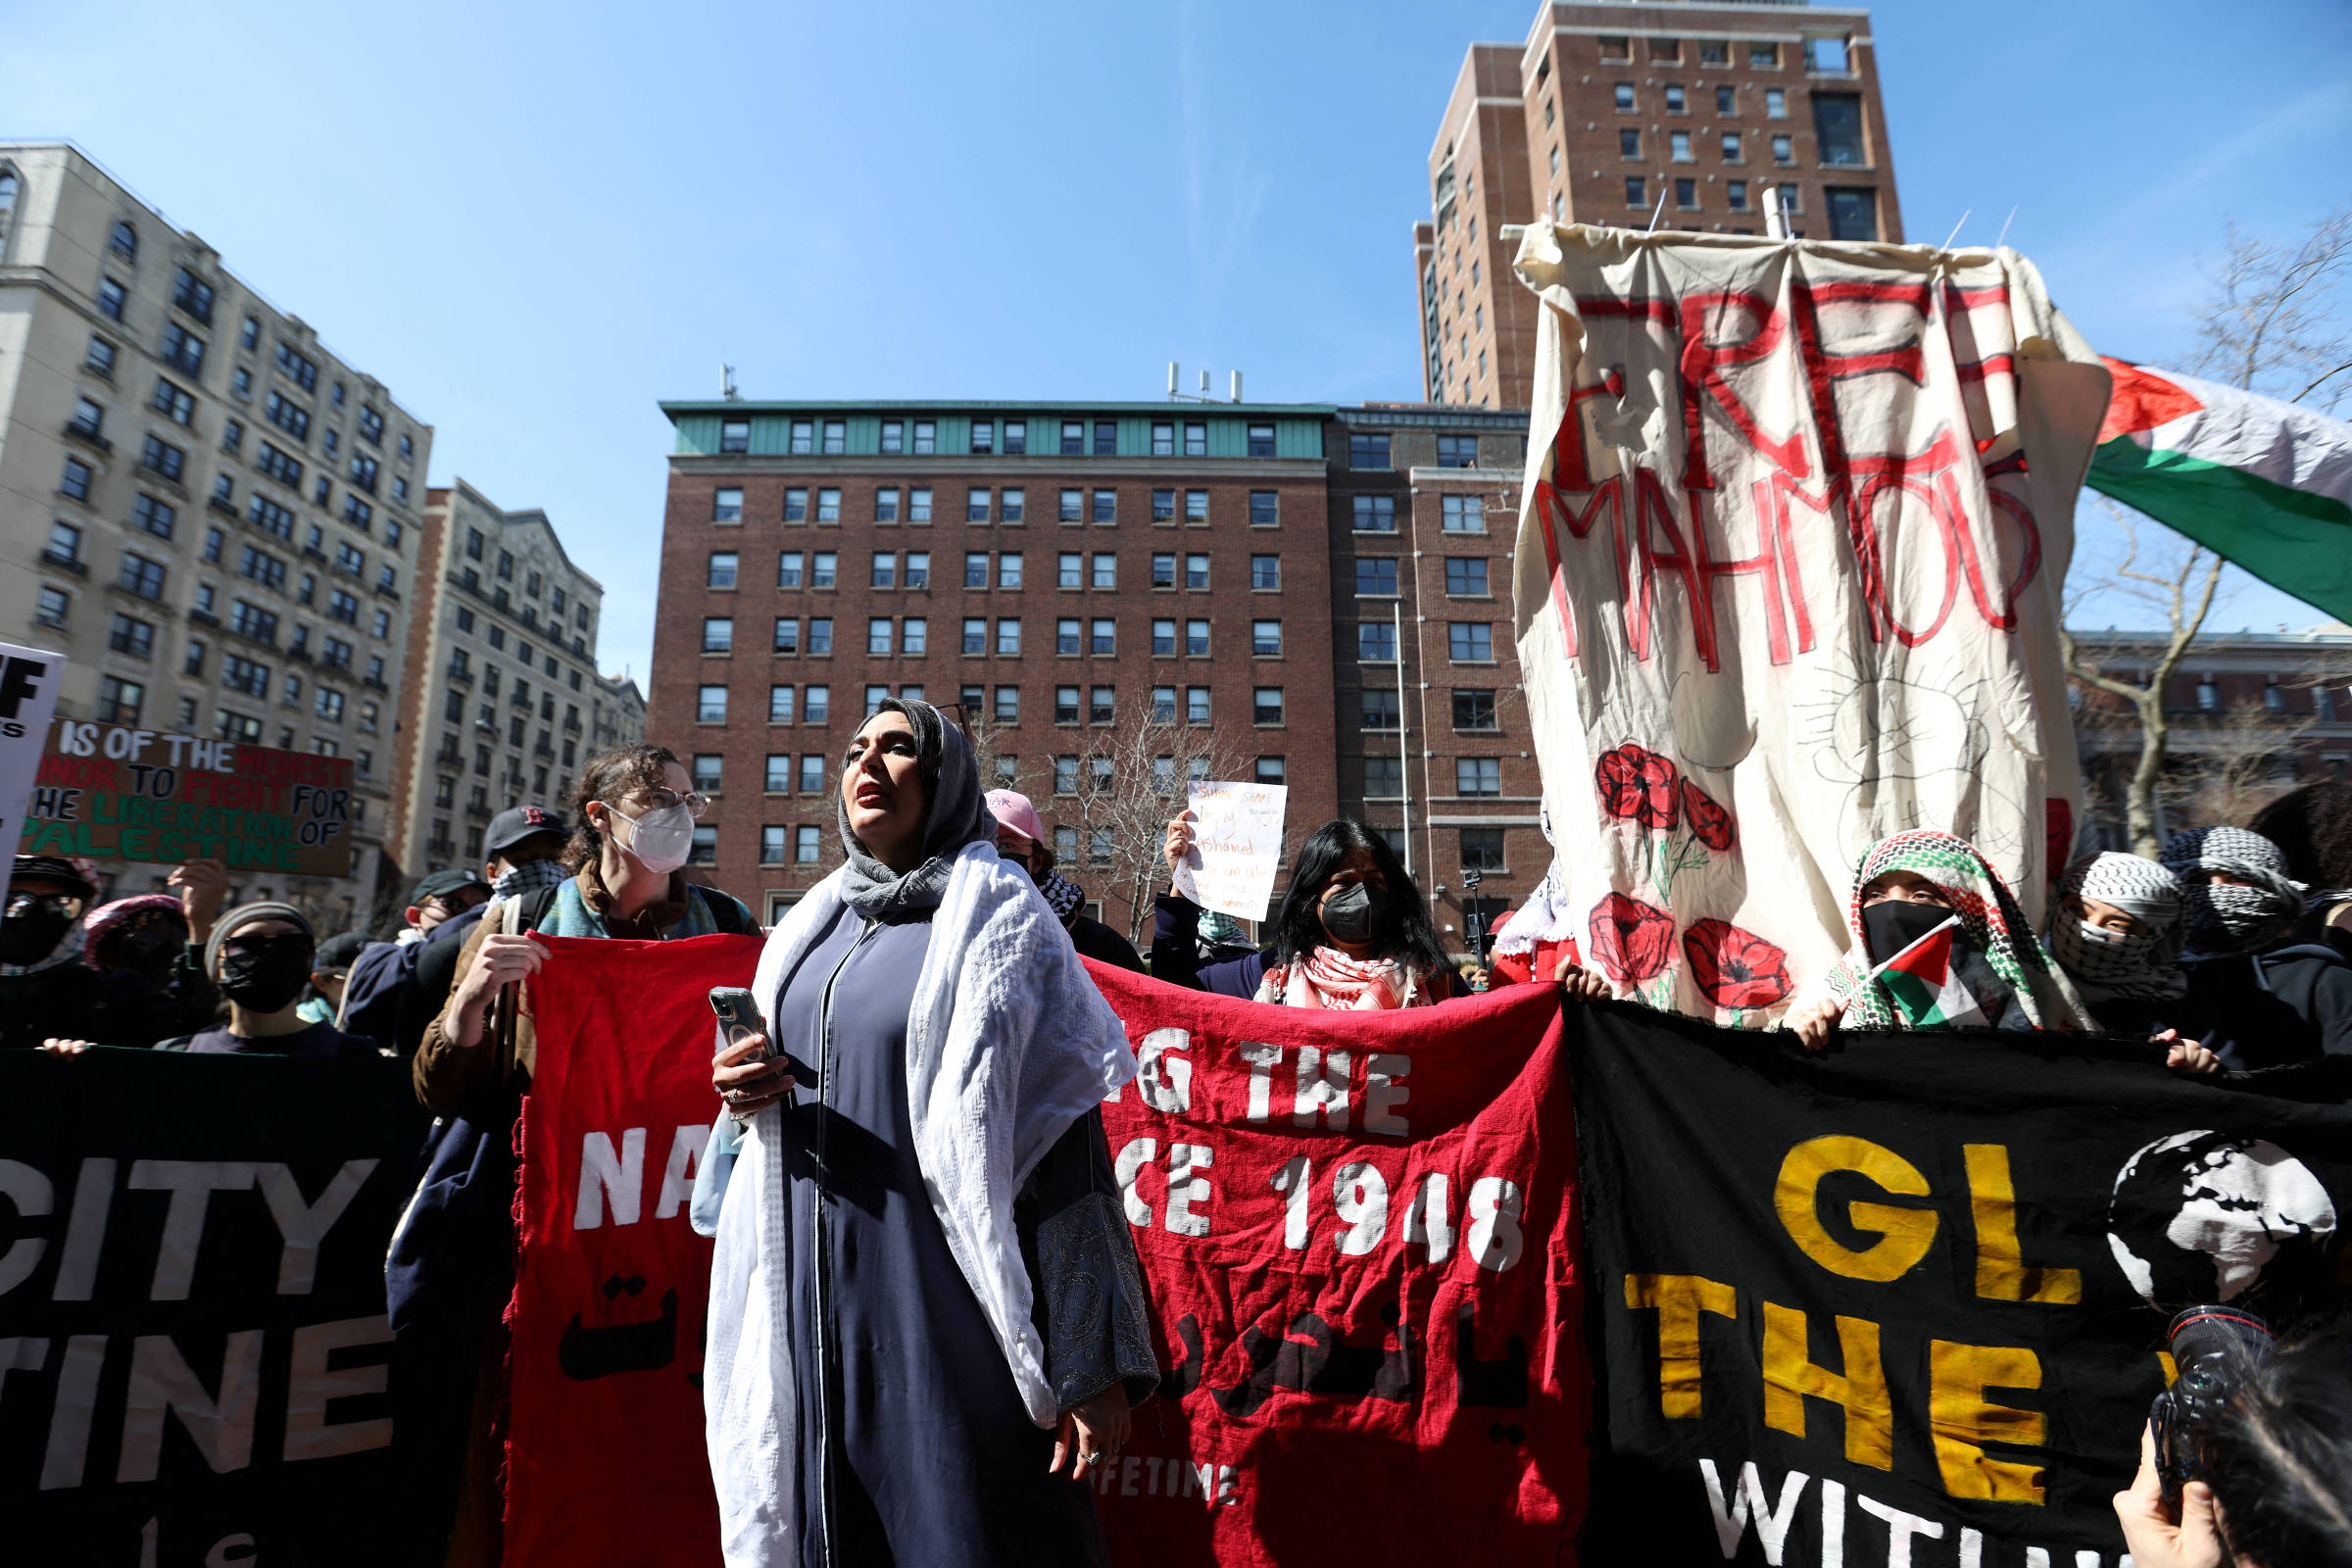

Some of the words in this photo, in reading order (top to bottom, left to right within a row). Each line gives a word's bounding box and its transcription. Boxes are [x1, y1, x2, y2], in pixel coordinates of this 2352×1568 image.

[1552, 276, 2031, 492] FREE
[0, 654, 47, 720] F
[59, 720, 100, 757] IS
[102, 727, 155, 763] OF
[161, 734, 236, 773] THE
[236, 744, 354, 788] HIGHEST
[125, 763, 178, 800] TO
[183, 770, 291, 811] FIGHT
[292, 785, 351, 822] FOR
[92, 793, 293, 842] LIBERATION
[297, 821, 342, 848] OF
[1239, 1040, 1411, 1137] THE
[1268, 1156, 1524, 1273] 1948
[1624, 1273, 2049, 1507] THE
